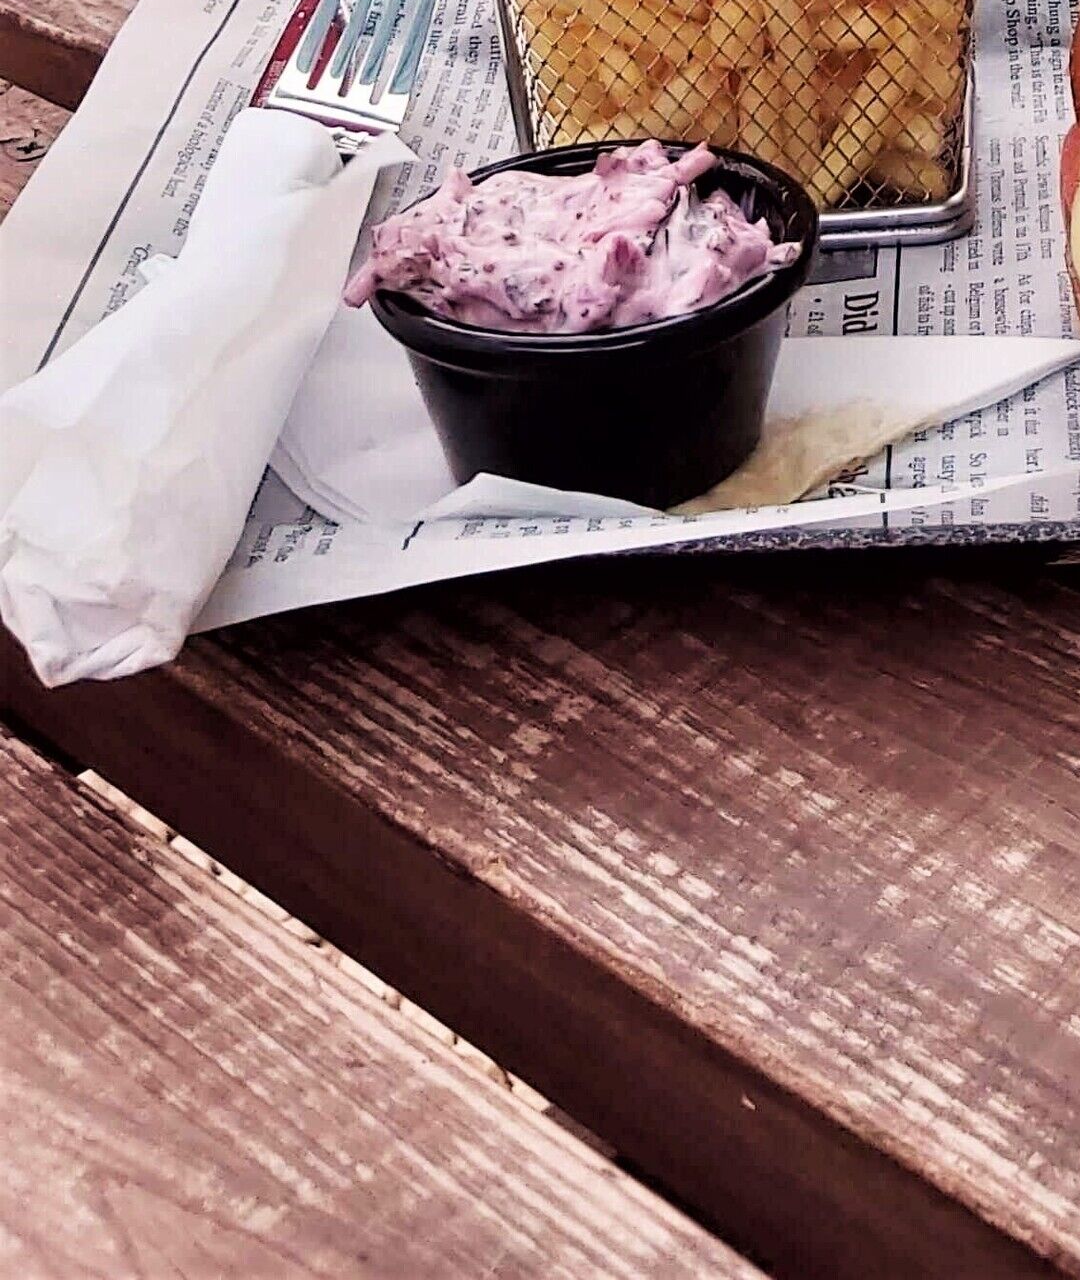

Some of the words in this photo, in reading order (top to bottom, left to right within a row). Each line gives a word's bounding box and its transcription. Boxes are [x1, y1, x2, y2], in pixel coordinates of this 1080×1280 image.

[1005, 8, 1022, 47] Shop
[1046, 0, 1062, 35] hung
[465, 35, 483, 66] they
[1009, 49, 1023, 61] in
[1010, 63, 1023, 81] the
[842, 290, 880, 336] Did
